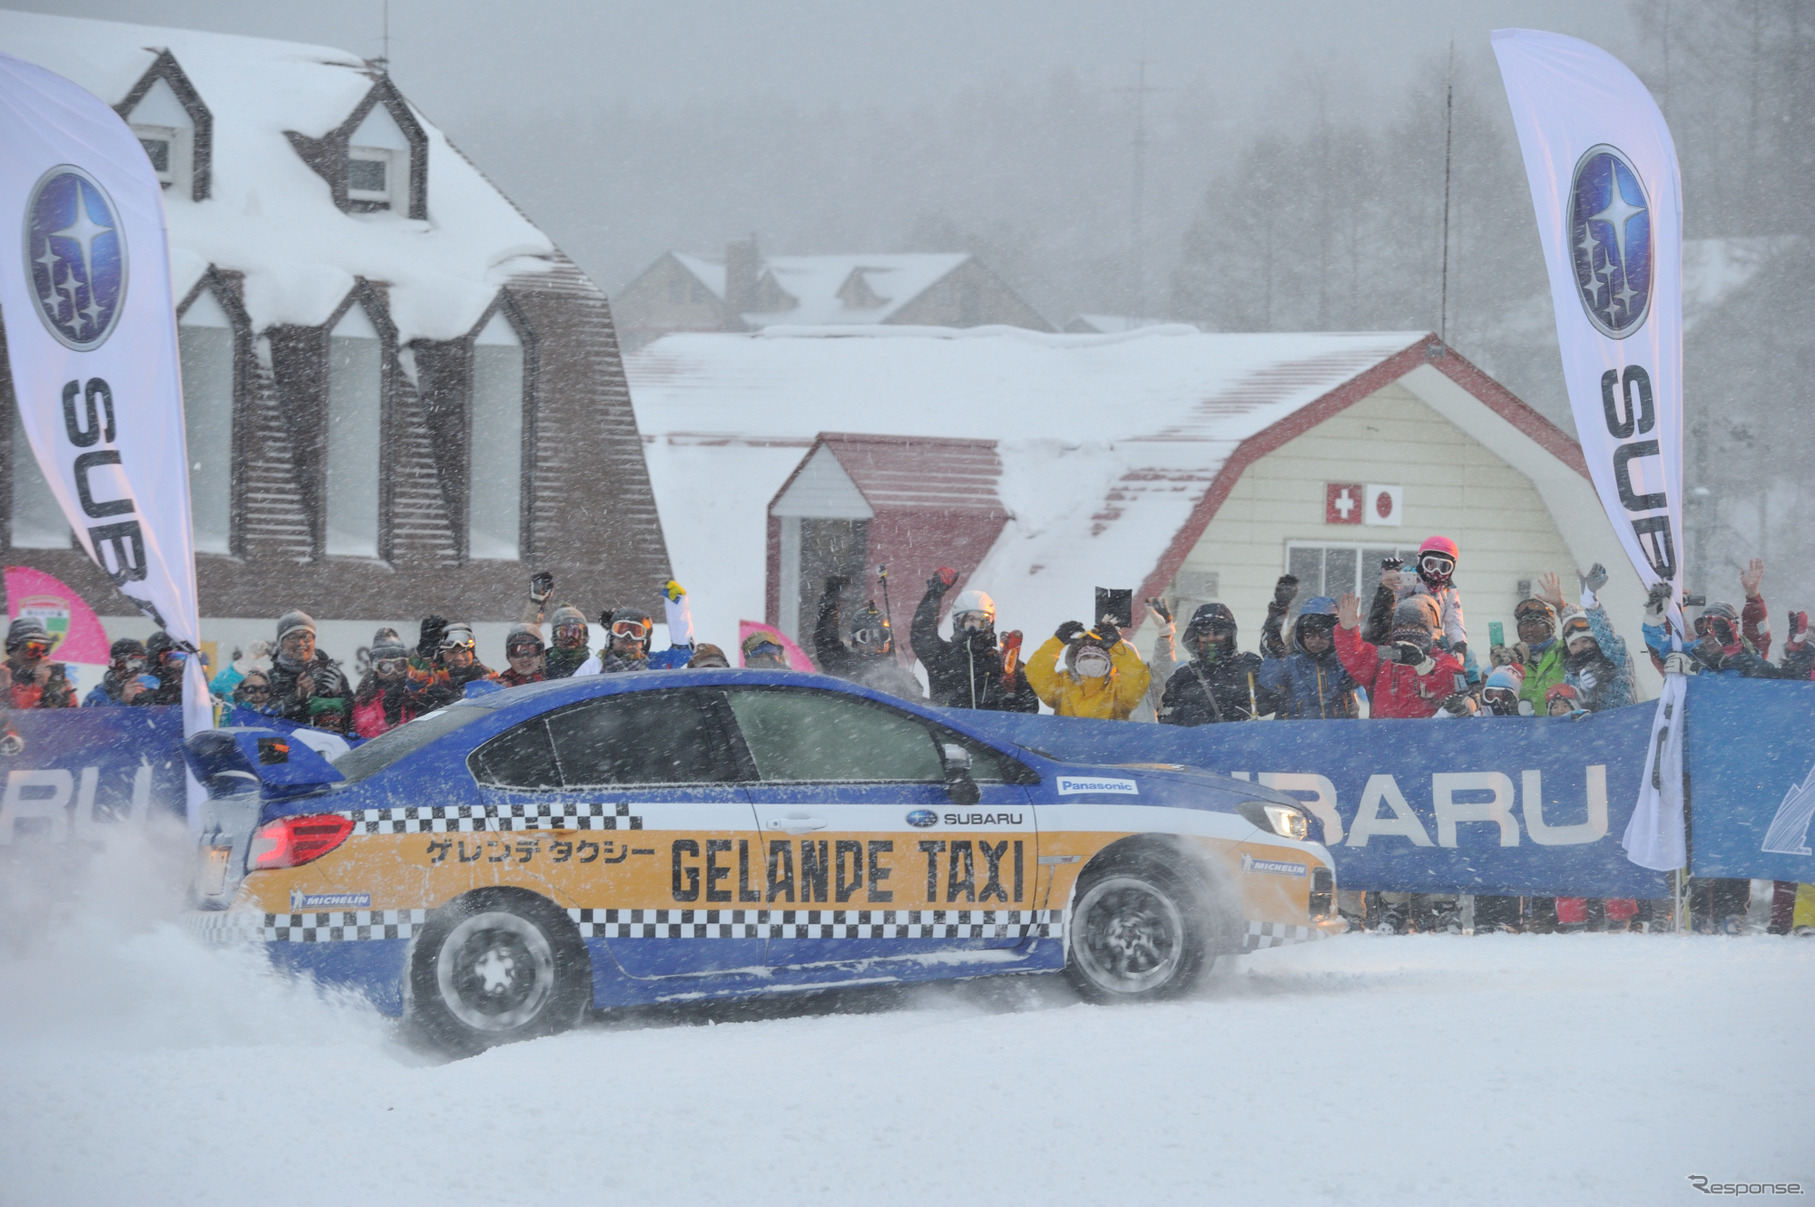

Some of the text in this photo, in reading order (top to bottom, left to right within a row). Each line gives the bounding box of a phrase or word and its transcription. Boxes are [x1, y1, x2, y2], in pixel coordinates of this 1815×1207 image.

[1600, 364, 1676, 581] SUB
[1062, 780, 1133, 791] Panasonic
[1231, 765, 1609, 848] BARU
[944, 813, 1023, 825] SUBARU
[671, 838, 1024, 903] GELANDE TAXI
[1253, 861, 1306, 874] MICHELIN
[306, 895, 369, 906] MICHELIN
